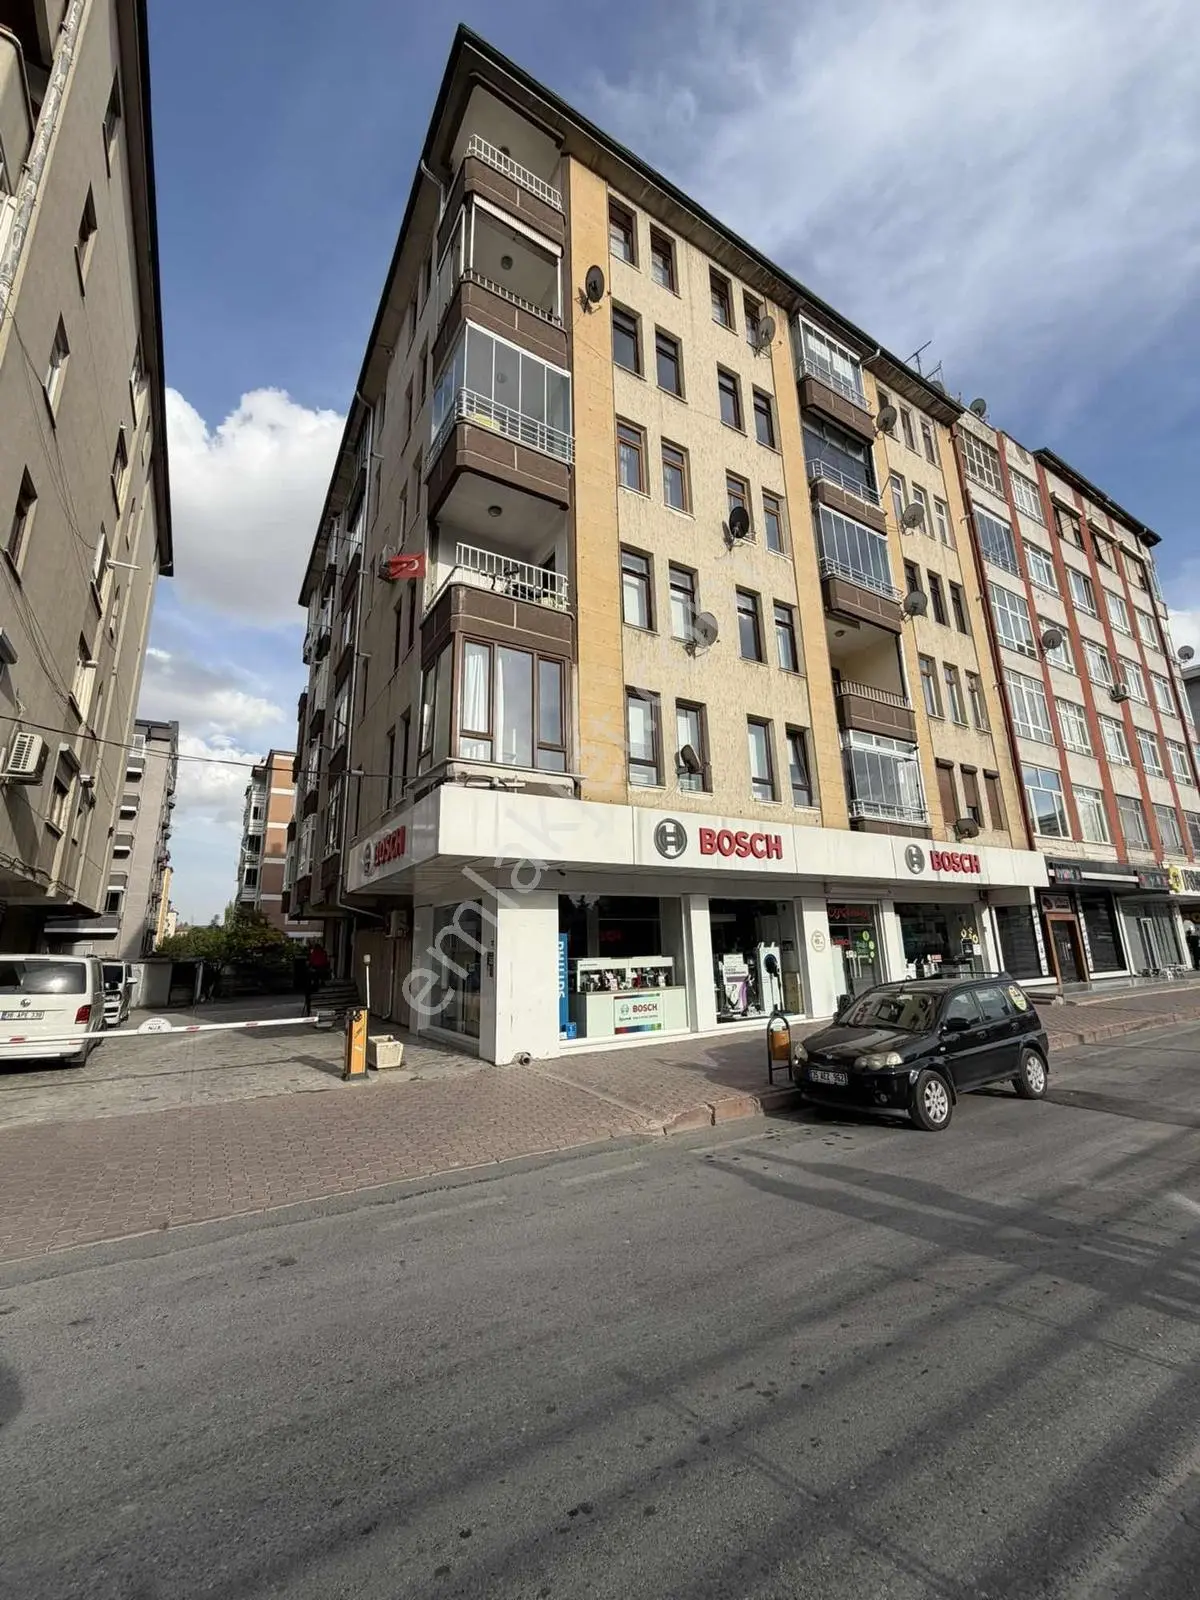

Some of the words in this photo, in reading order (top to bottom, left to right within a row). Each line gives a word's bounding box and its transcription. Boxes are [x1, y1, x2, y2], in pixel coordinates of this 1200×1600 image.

[699, 826, 783, 860] BOSCH
[930, 849, 981, 875] BOSCH
[632, 1003, 658, 1014] BOSCH
